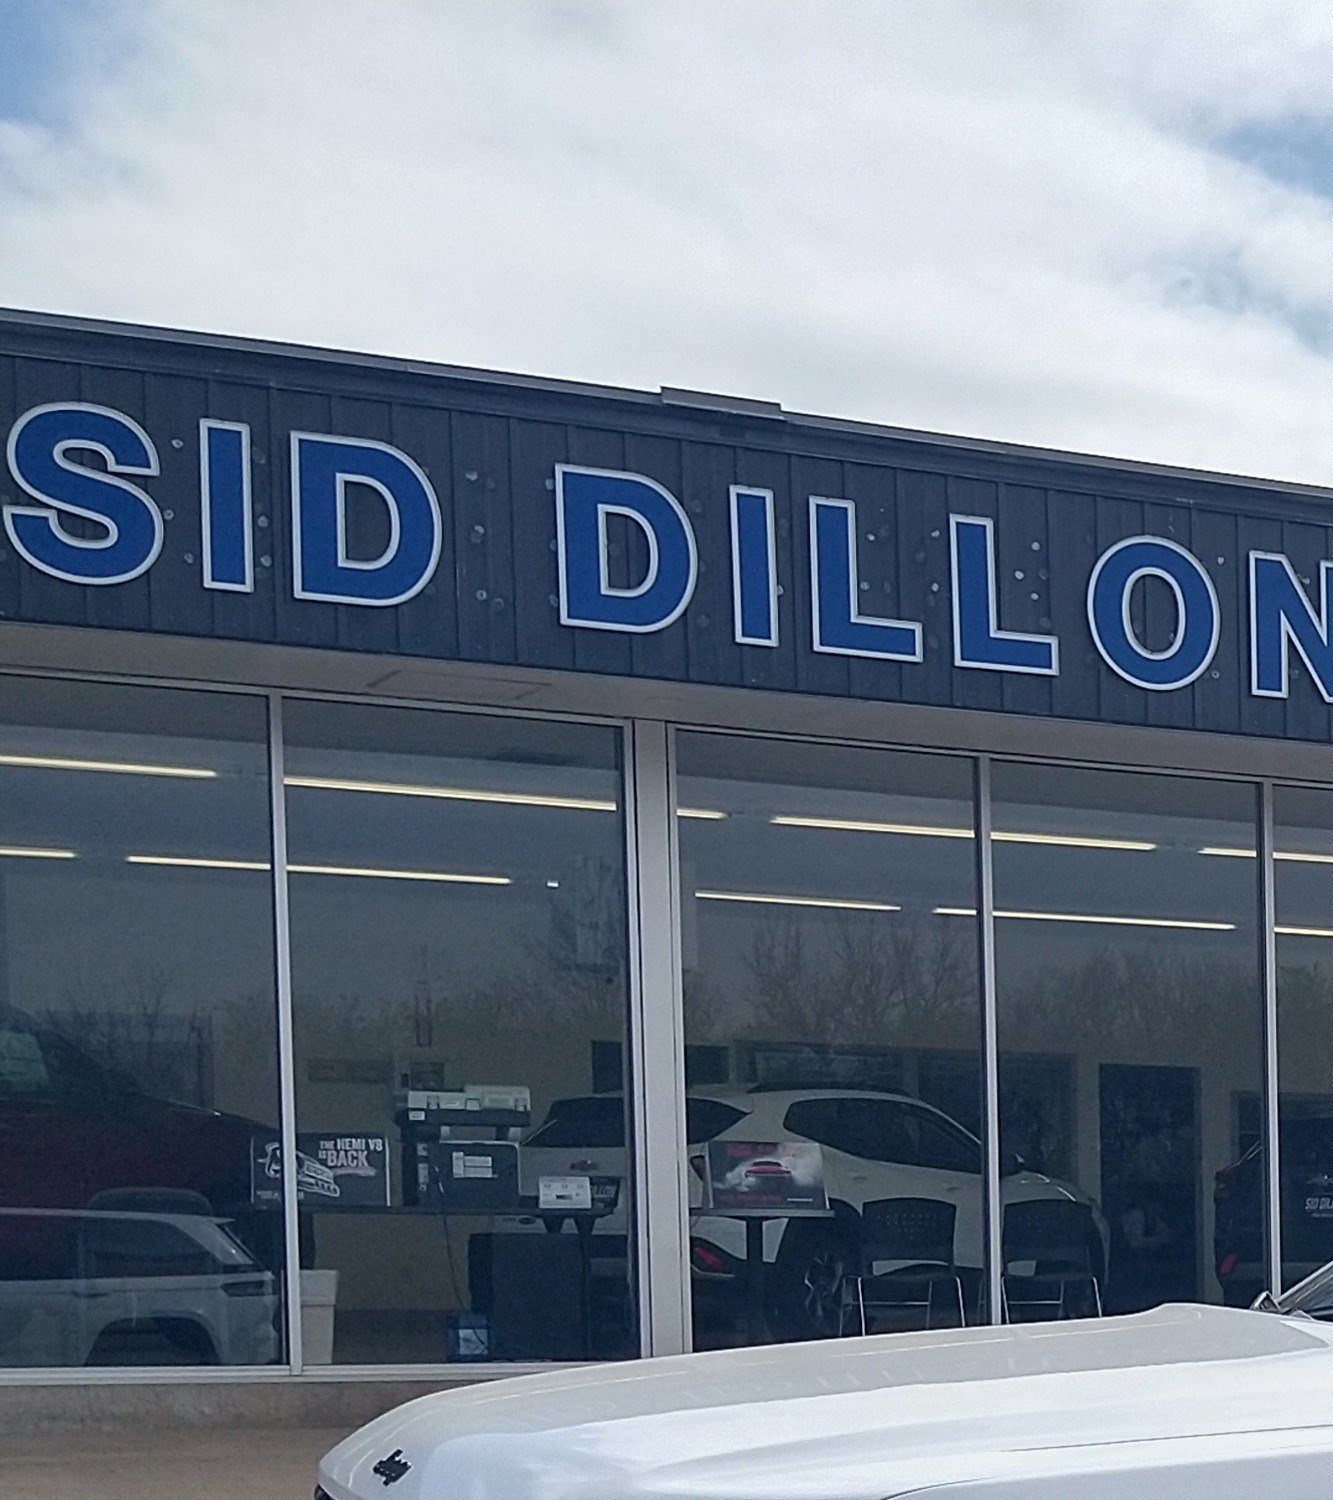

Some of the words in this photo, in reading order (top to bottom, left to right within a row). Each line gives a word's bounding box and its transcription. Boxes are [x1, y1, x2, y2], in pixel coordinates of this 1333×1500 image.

[3, 401, 443, 607] SID
[337, 1138, 366, 1150] HEMI
[368, 1138, 383, 1151] V8
[327, 1150, 368, 1167] BACK
